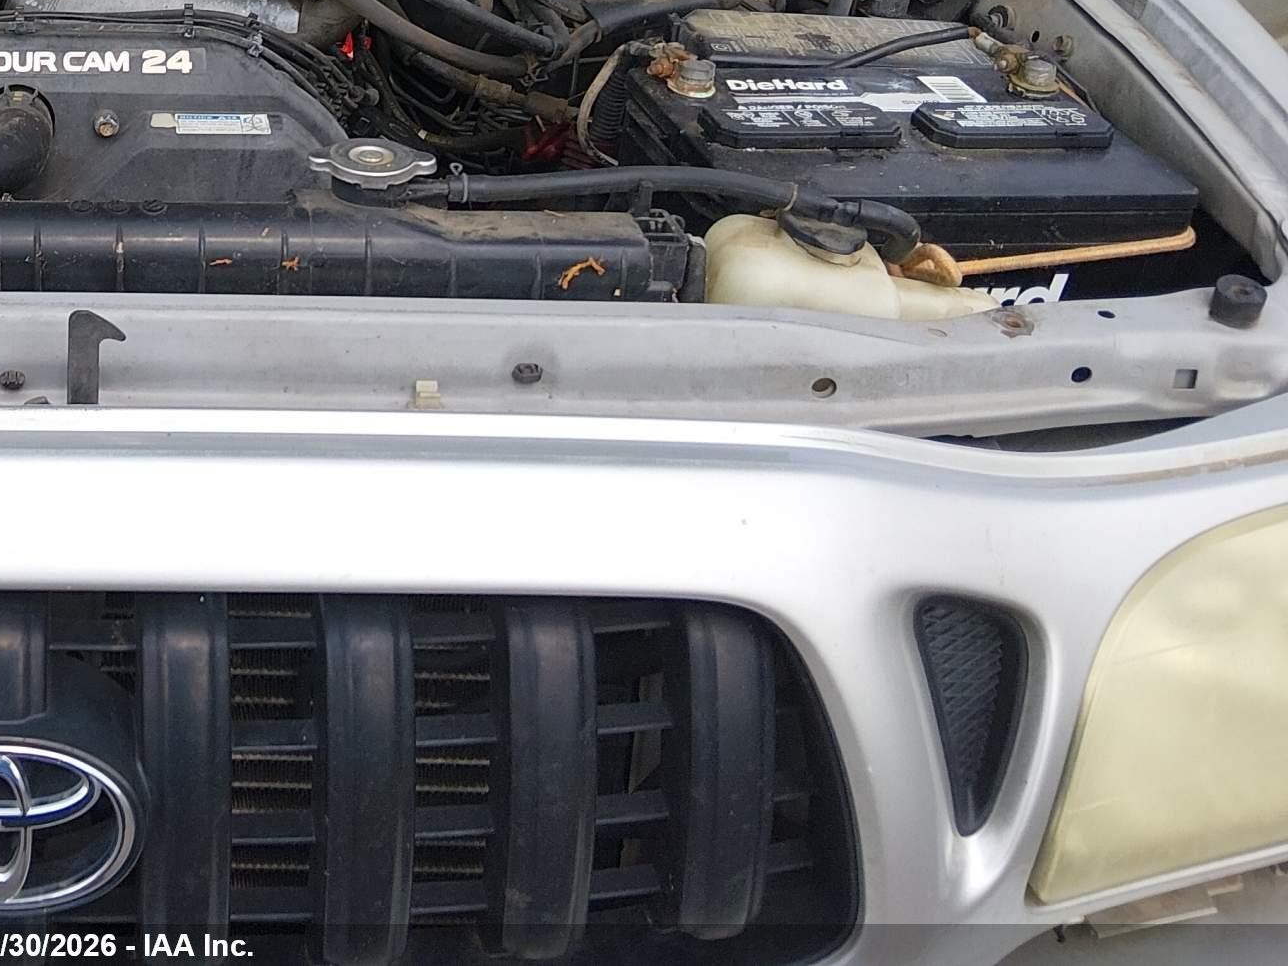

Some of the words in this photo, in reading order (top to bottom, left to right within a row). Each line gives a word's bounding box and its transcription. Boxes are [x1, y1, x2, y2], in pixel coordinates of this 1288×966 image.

[62, 50, 130, 73] CAM
[141, 49, 193, 74] 24
[726, 78, 849, 92] DieHard
